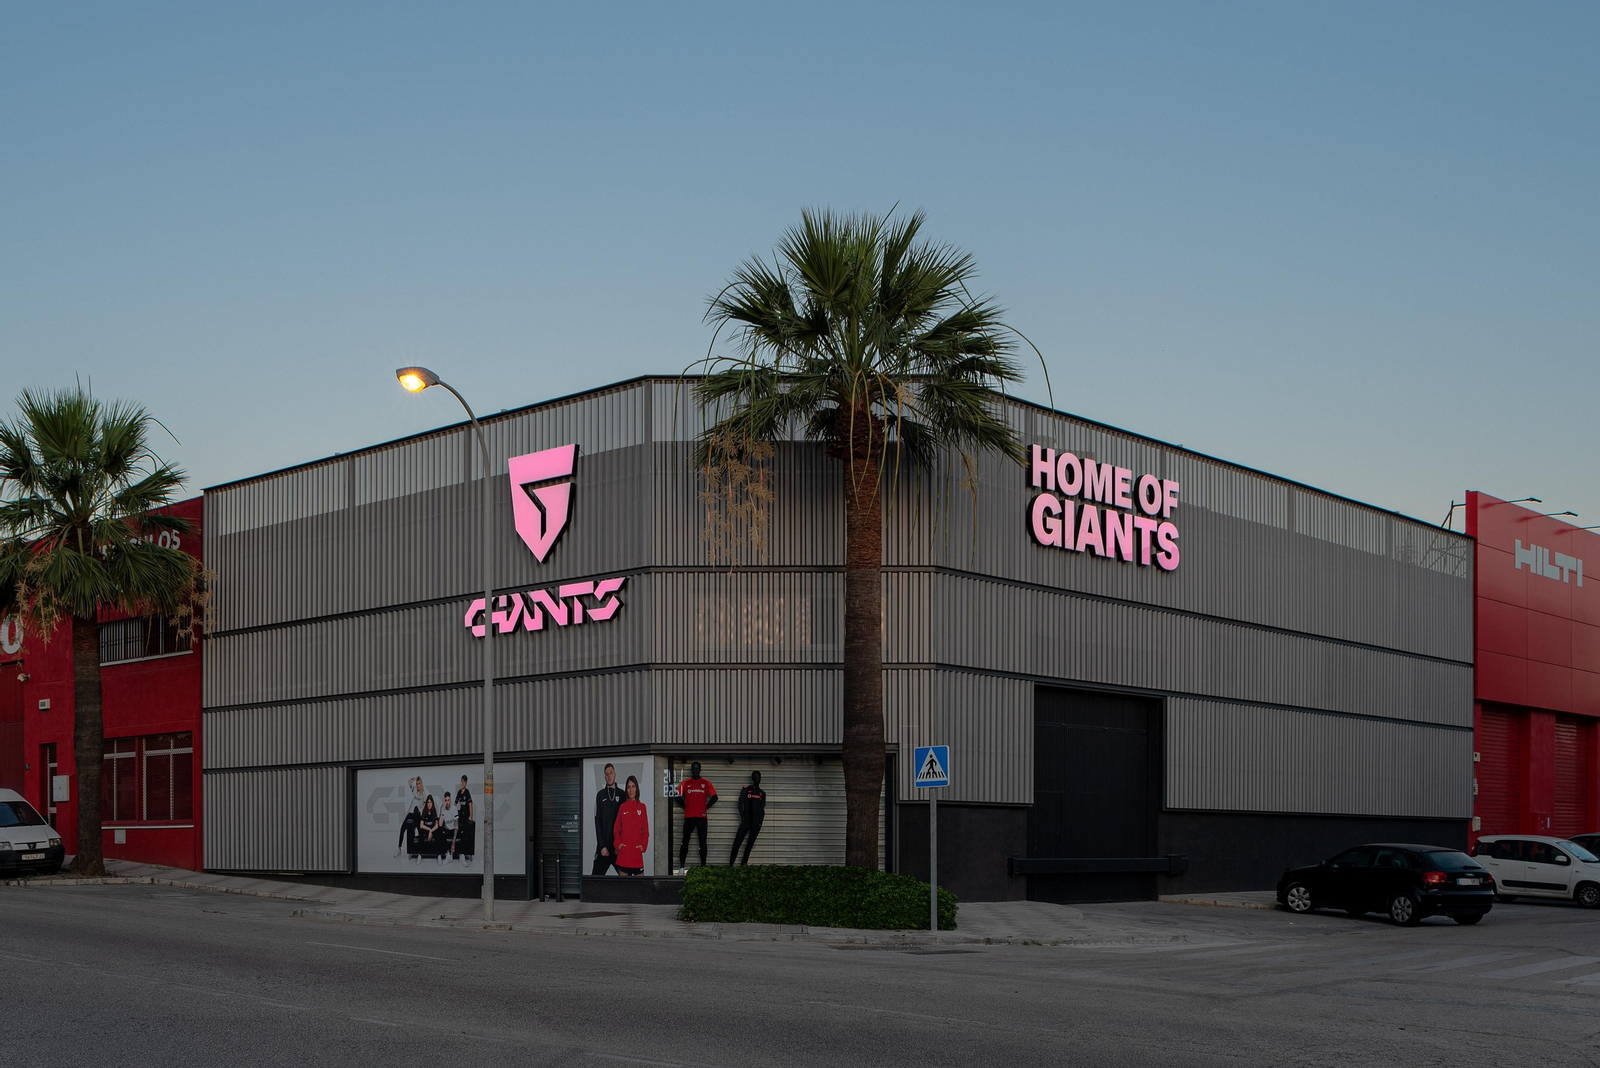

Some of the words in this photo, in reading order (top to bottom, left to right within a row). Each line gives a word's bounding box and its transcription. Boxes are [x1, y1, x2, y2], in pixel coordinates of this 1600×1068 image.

[1030, 444, 1133, 510] HOME
[1136, 473, 1180, 519] OF
[1030, 493, 1180, 572] GIANTS
[1514, 538, 1583, 588] HILTI
[464, 577, 627, 638] GIANTS
